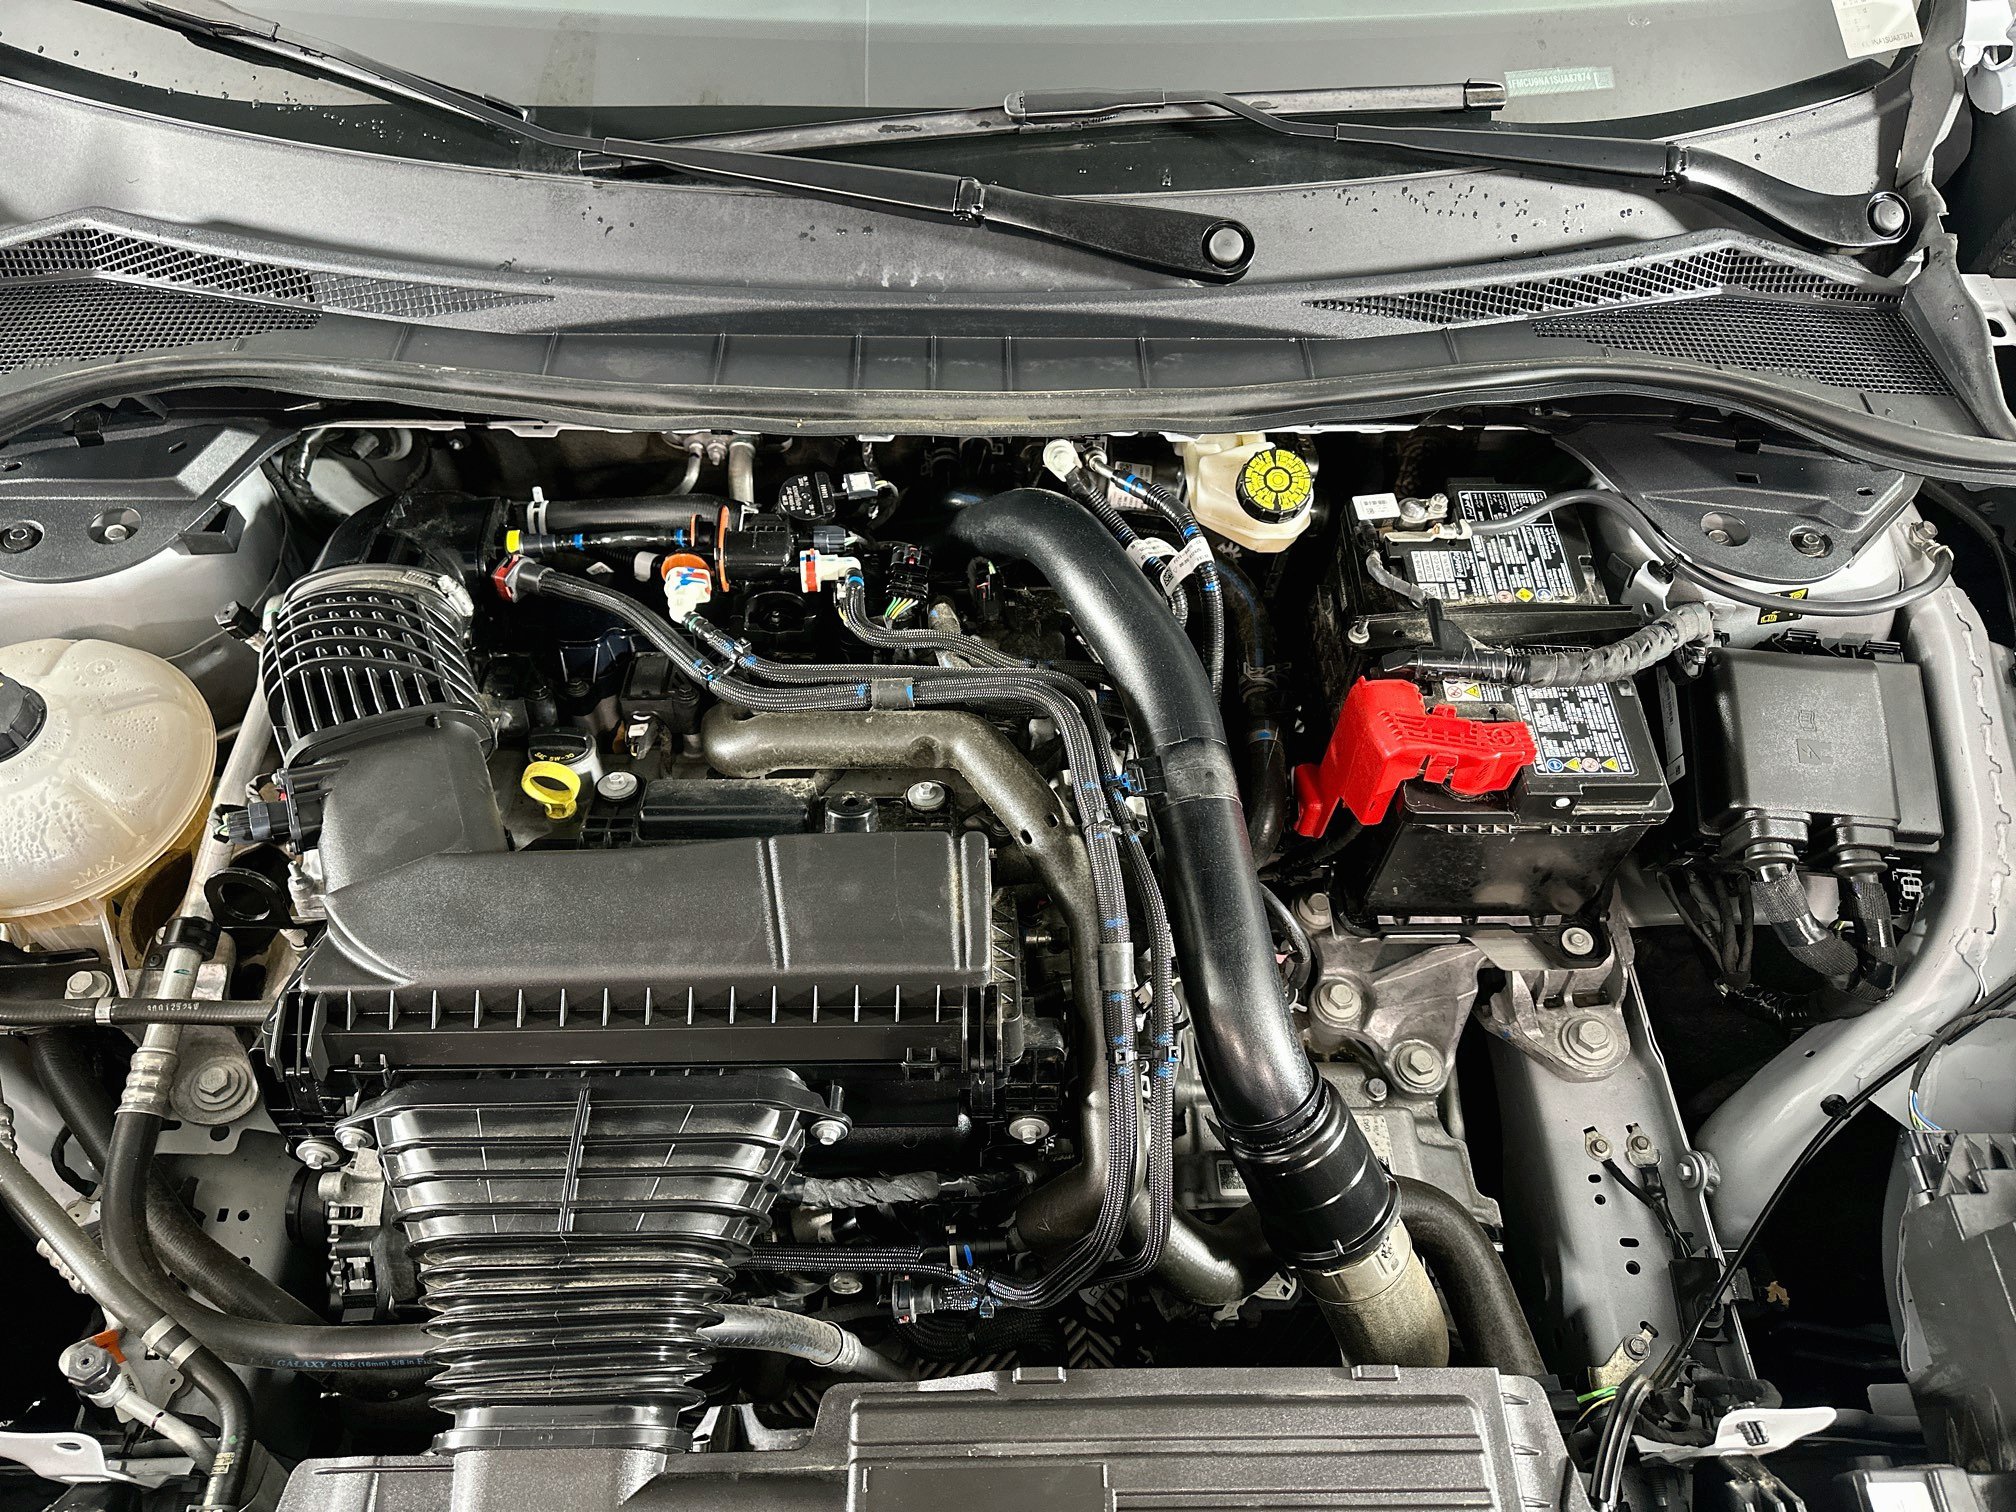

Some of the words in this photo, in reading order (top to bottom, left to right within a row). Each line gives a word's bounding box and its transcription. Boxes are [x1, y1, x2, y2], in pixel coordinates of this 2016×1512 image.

[549, 753, 575, 762] 5W-30
[78, 855, 122, 883] MAX
[277, 1359, 328, 1368] GALAXY
[331, 1360, 356, 1368] 4886
